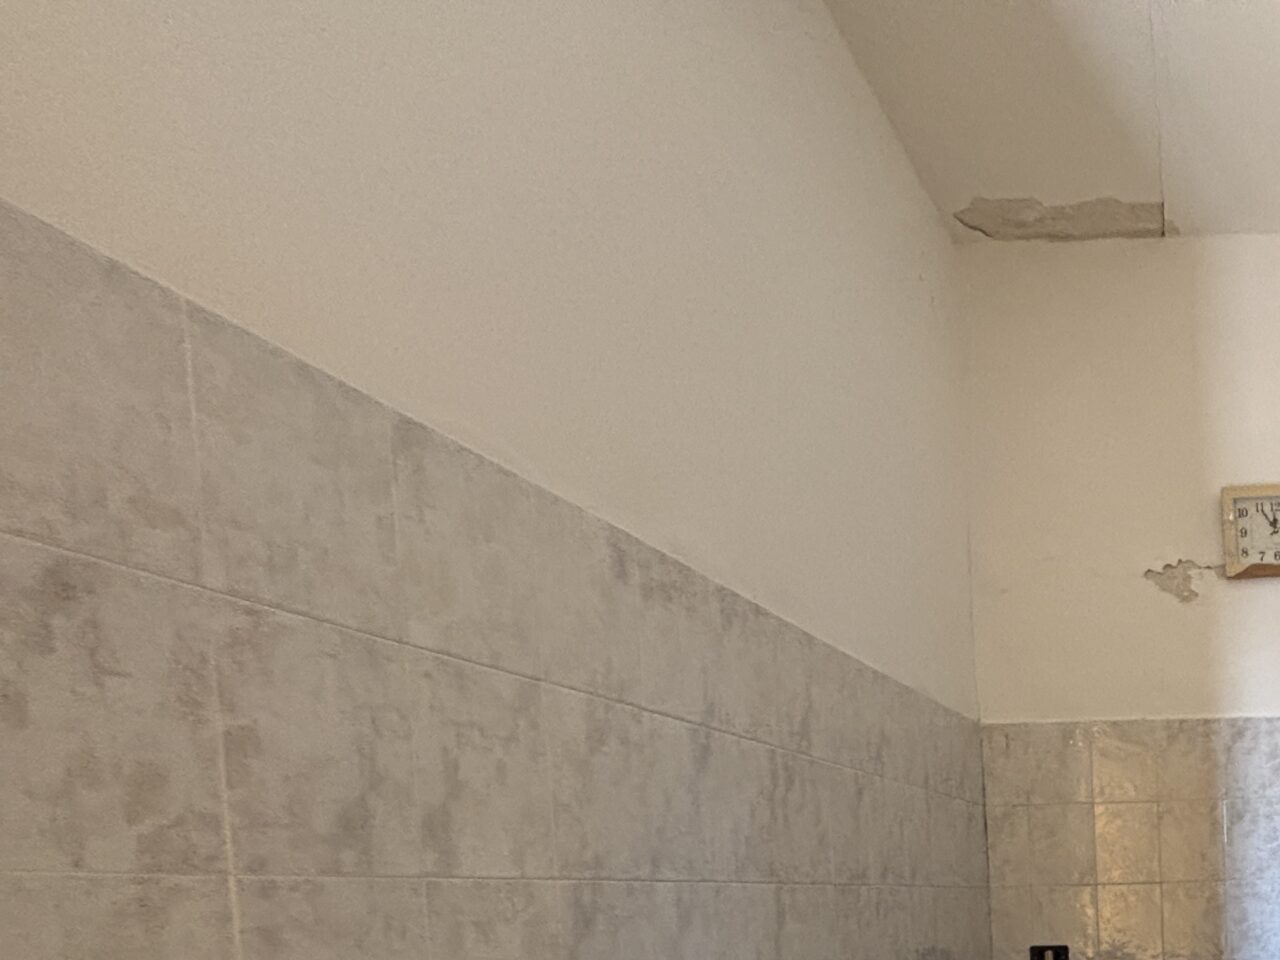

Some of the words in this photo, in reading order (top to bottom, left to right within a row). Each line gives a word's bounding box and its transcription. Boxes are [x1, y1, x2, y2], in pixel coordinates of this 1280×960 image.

[1269, 502, 1280, 512] 12
[1237, 508, 1248, 518] 10
[1240, 528, 1247, 538] 9
[1241, 548, 1249, 558] 8
[1258, 551, 1266, 562] 7
[1274, 551, 1280, 560] 6
